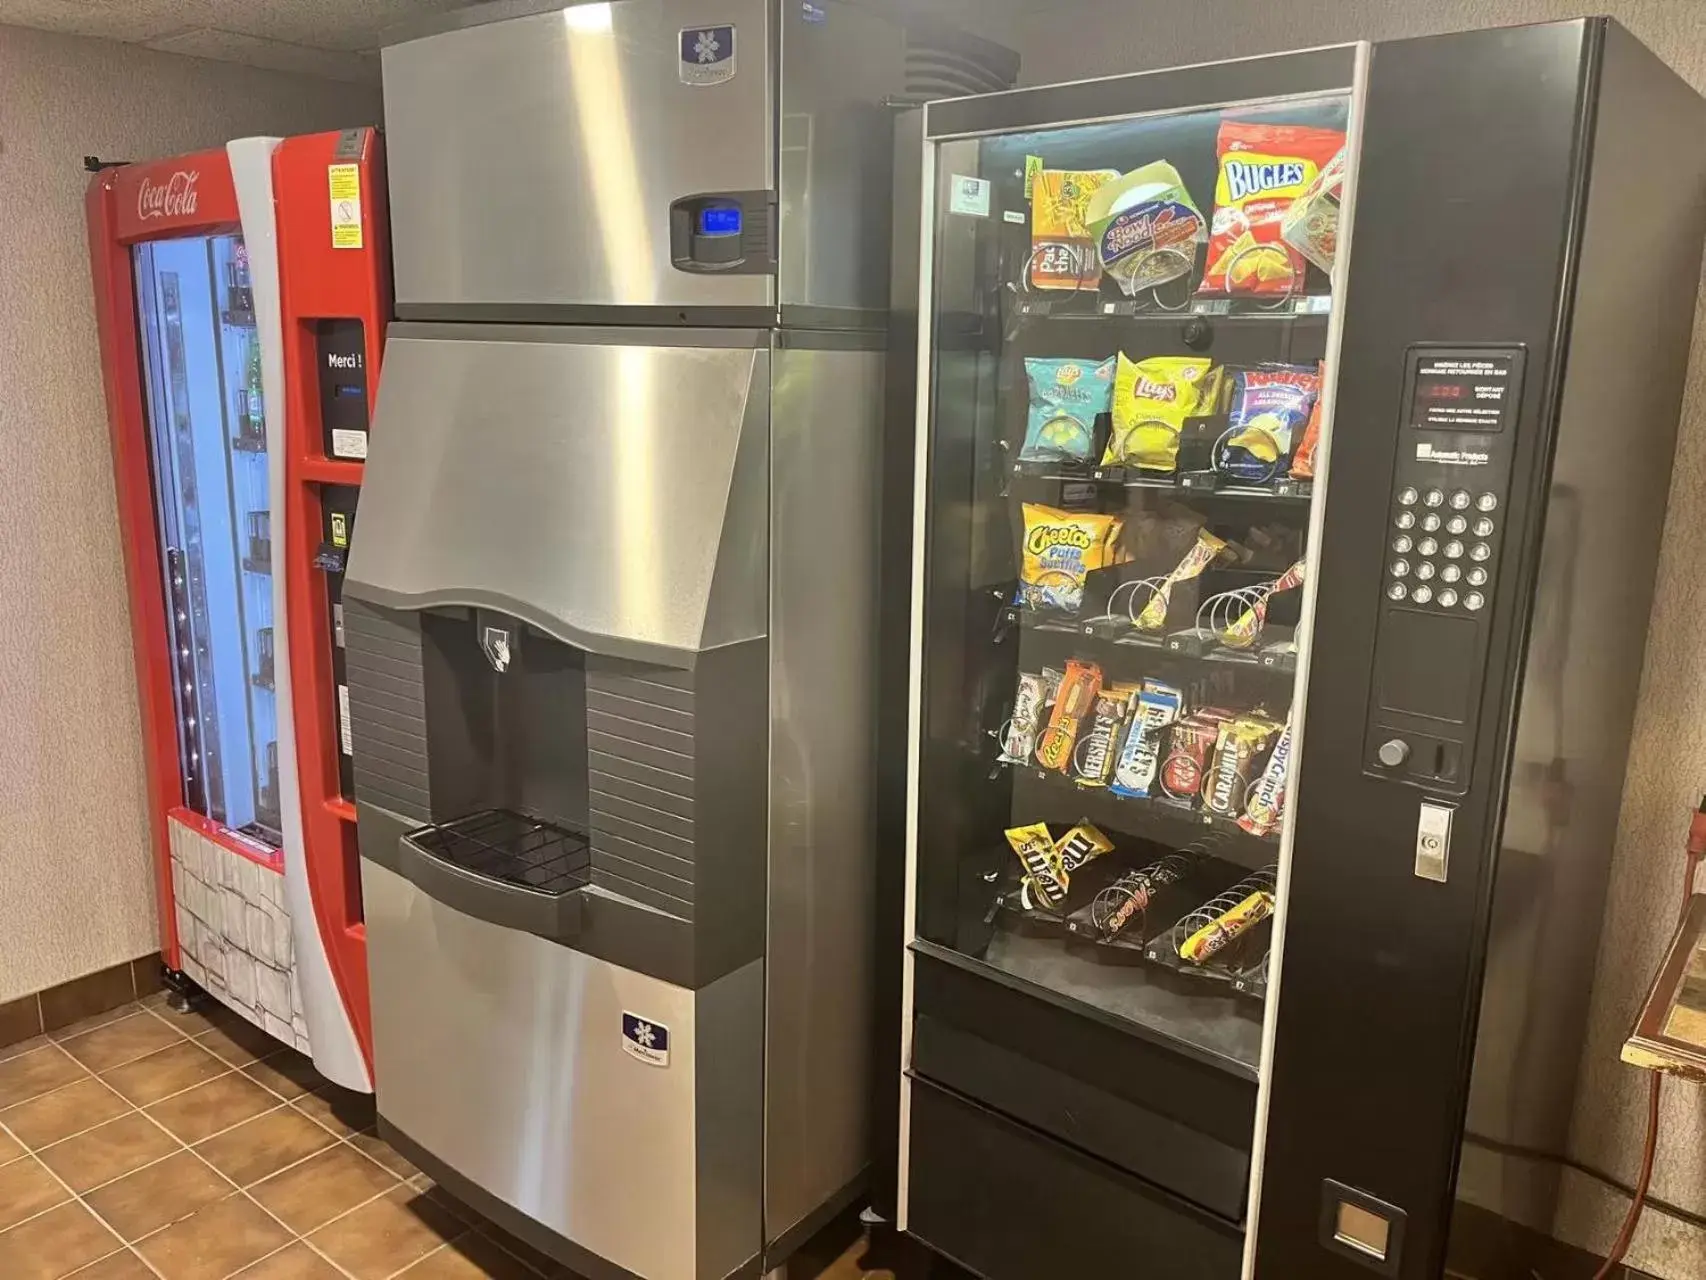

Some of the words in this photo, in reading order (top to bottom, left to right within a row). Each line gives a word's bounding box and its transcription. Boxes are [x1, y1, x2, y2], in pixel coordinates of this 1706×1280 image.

[138, 170, 200, 220] Coca-Cola
[1225, 161, 1304, 201] BUGLES
[328, 353, 356, 368] Merci
[1136, 377, 1175, 400] Lay's
[1028, 525, 1091, 555] Cheetos
[1211, 740, 1238, 810] CARAMILK
